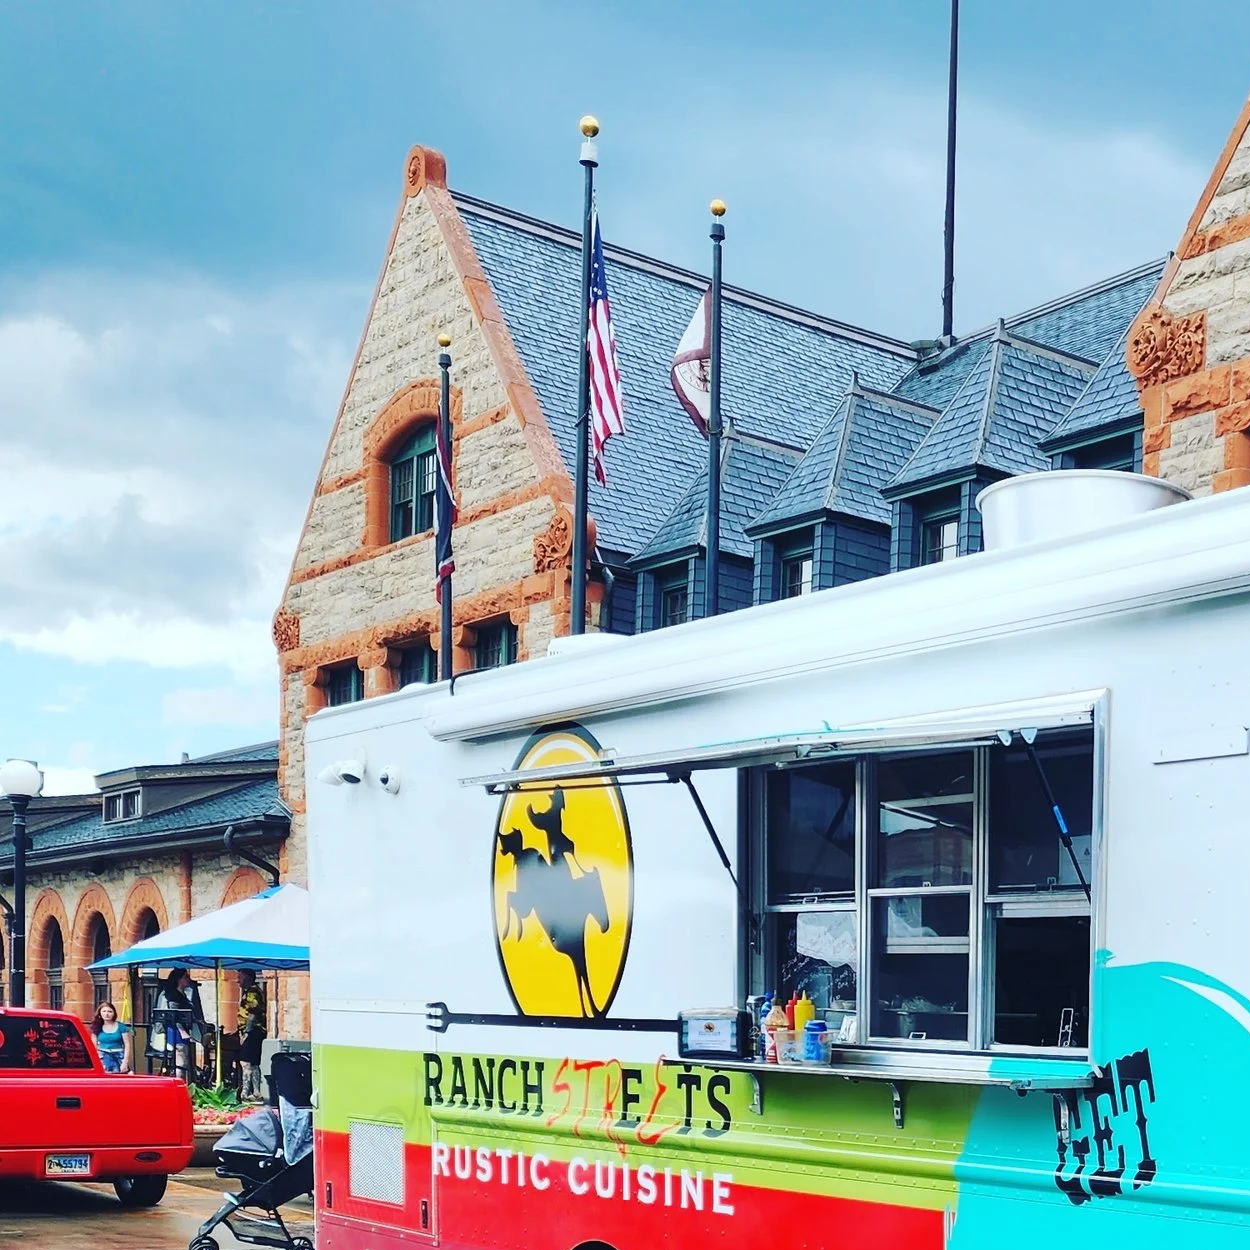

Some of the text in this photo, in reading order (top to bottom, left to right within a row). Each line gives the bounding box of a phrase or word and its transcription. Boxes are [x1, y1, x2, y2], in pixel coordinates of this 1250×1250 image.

[423, 1053, 544, 1116] RANCH
[1053, 1048, 1157, 1205] GET
[433, 1142, 735, 1216] RUSTIC CUISINE
